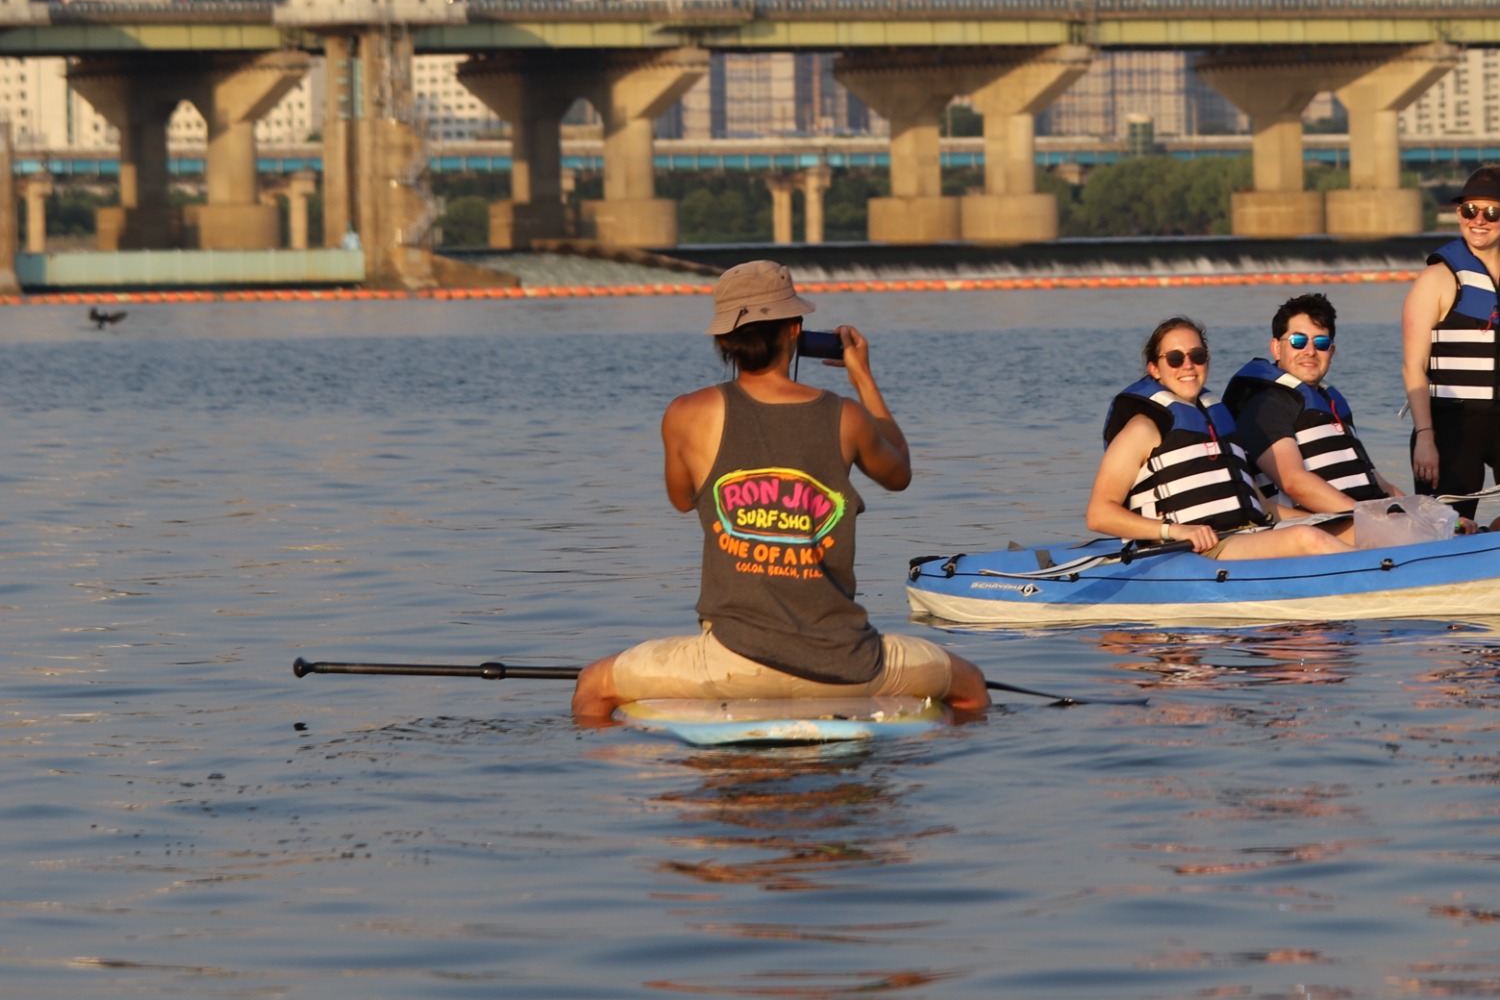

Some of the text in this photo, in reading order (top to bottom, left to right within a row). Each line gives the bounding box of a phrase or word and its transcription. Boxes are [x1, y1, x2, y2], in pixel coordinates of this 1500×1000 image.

[723, 478, 780, 511] RON
[736, 508, 812, 531] SURF SHO
[719, 532, 750, 558] ONE
[753, 544, 781, 563] OF
[784, 547, 797, 565] A
[736, 561, 765, 574] COCOA
